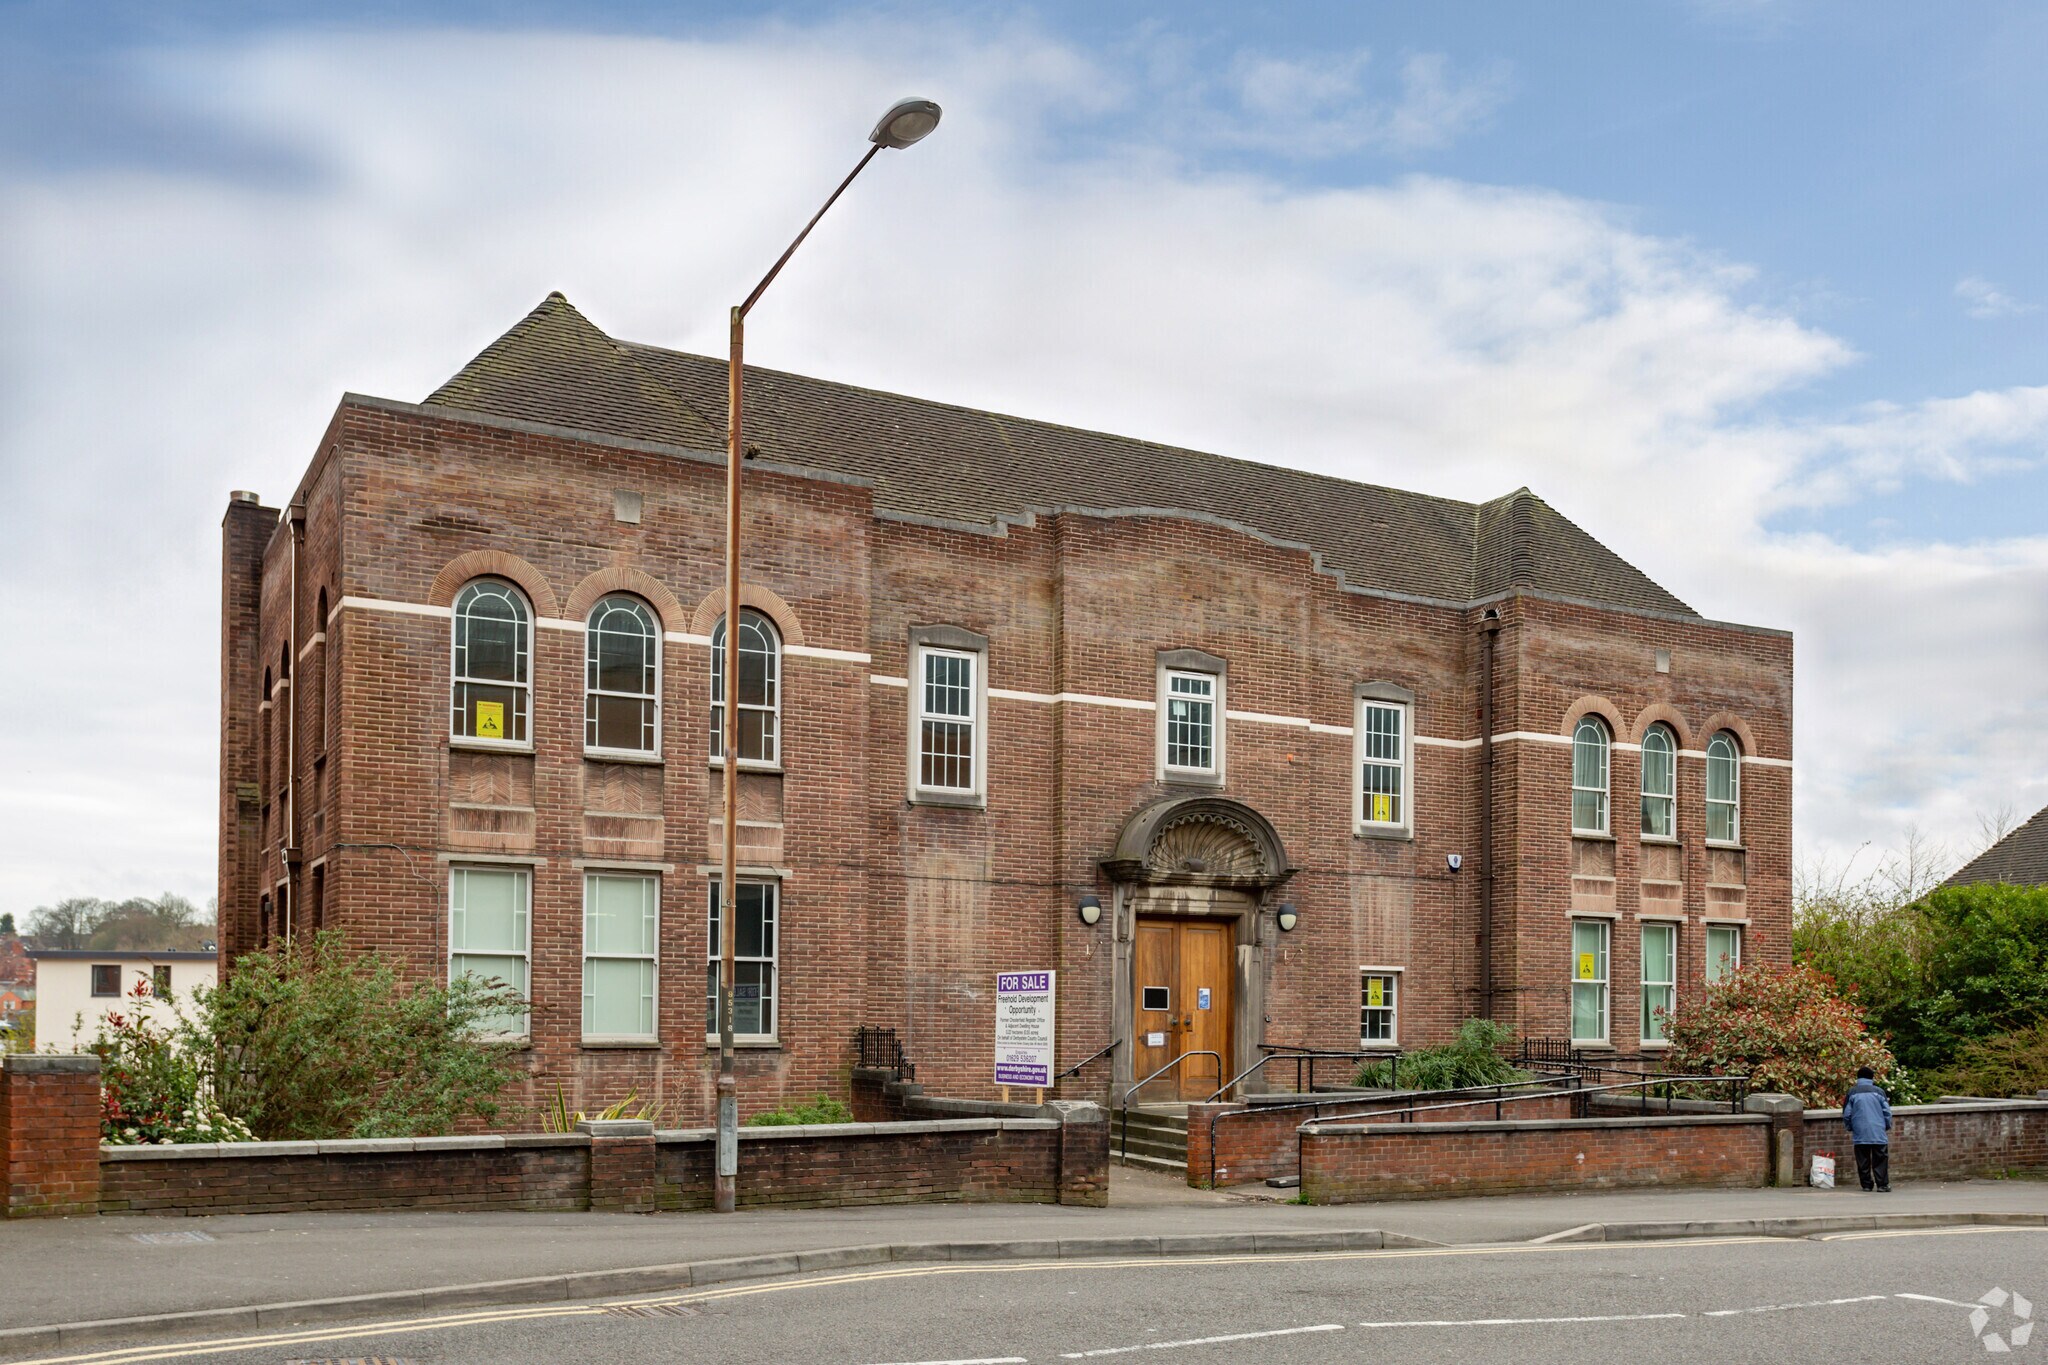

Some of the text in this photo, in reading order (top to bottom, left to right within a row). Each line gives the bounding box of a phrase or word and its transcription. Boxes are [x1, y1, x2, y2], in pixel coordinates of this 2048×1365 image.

[1001, 976, 1046, 990] FOR SALE
[998, 994, 1048, 1004] Freehold Development
[1009, 1005, 1036, 1015] Opportunity
[997, 1065, 1046, 1074] www.derbyshire.gov.uk
